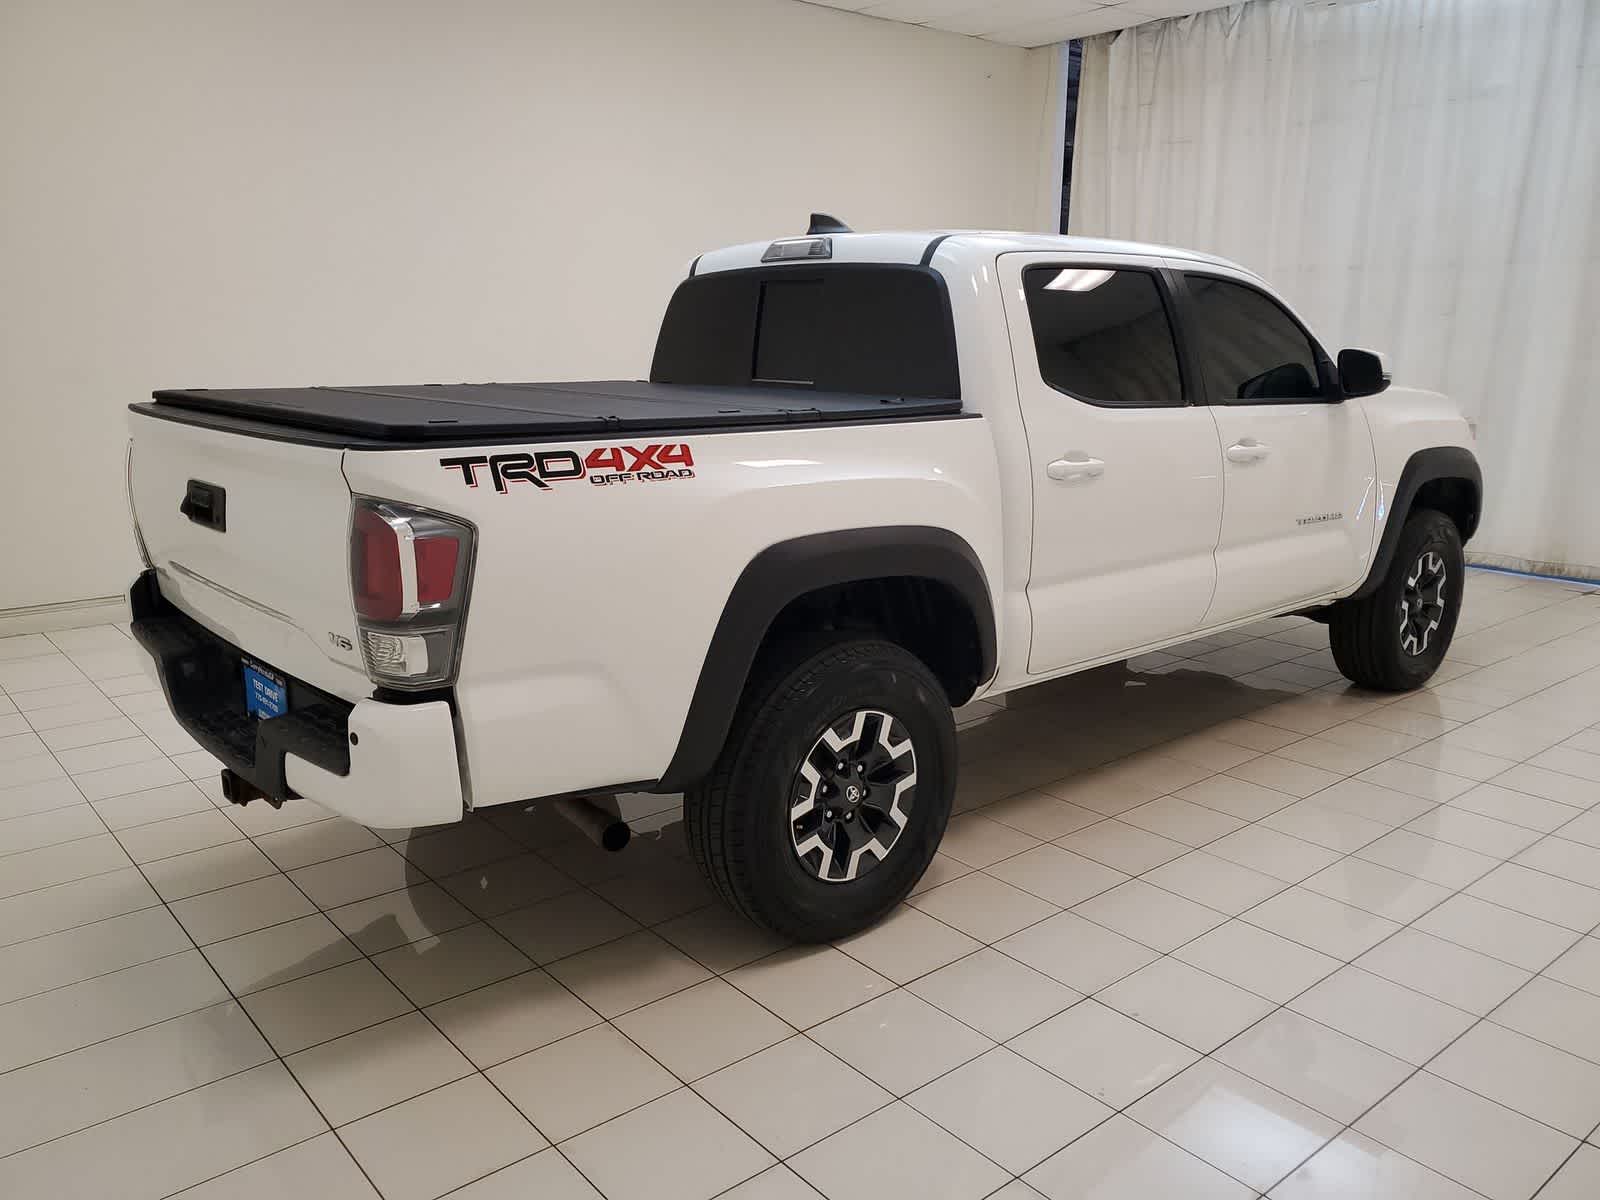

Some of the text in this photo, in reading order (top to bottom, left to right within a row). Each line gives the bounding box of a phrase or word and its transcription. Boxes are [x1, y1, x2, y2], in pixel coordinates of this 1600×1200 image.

[439, 450, 587, 494] TRD
[589, 468, 696, 487] OFF ROAD
[252, 678, 264, 693] TEST
[264, 685, 279, 703] DRIVE
